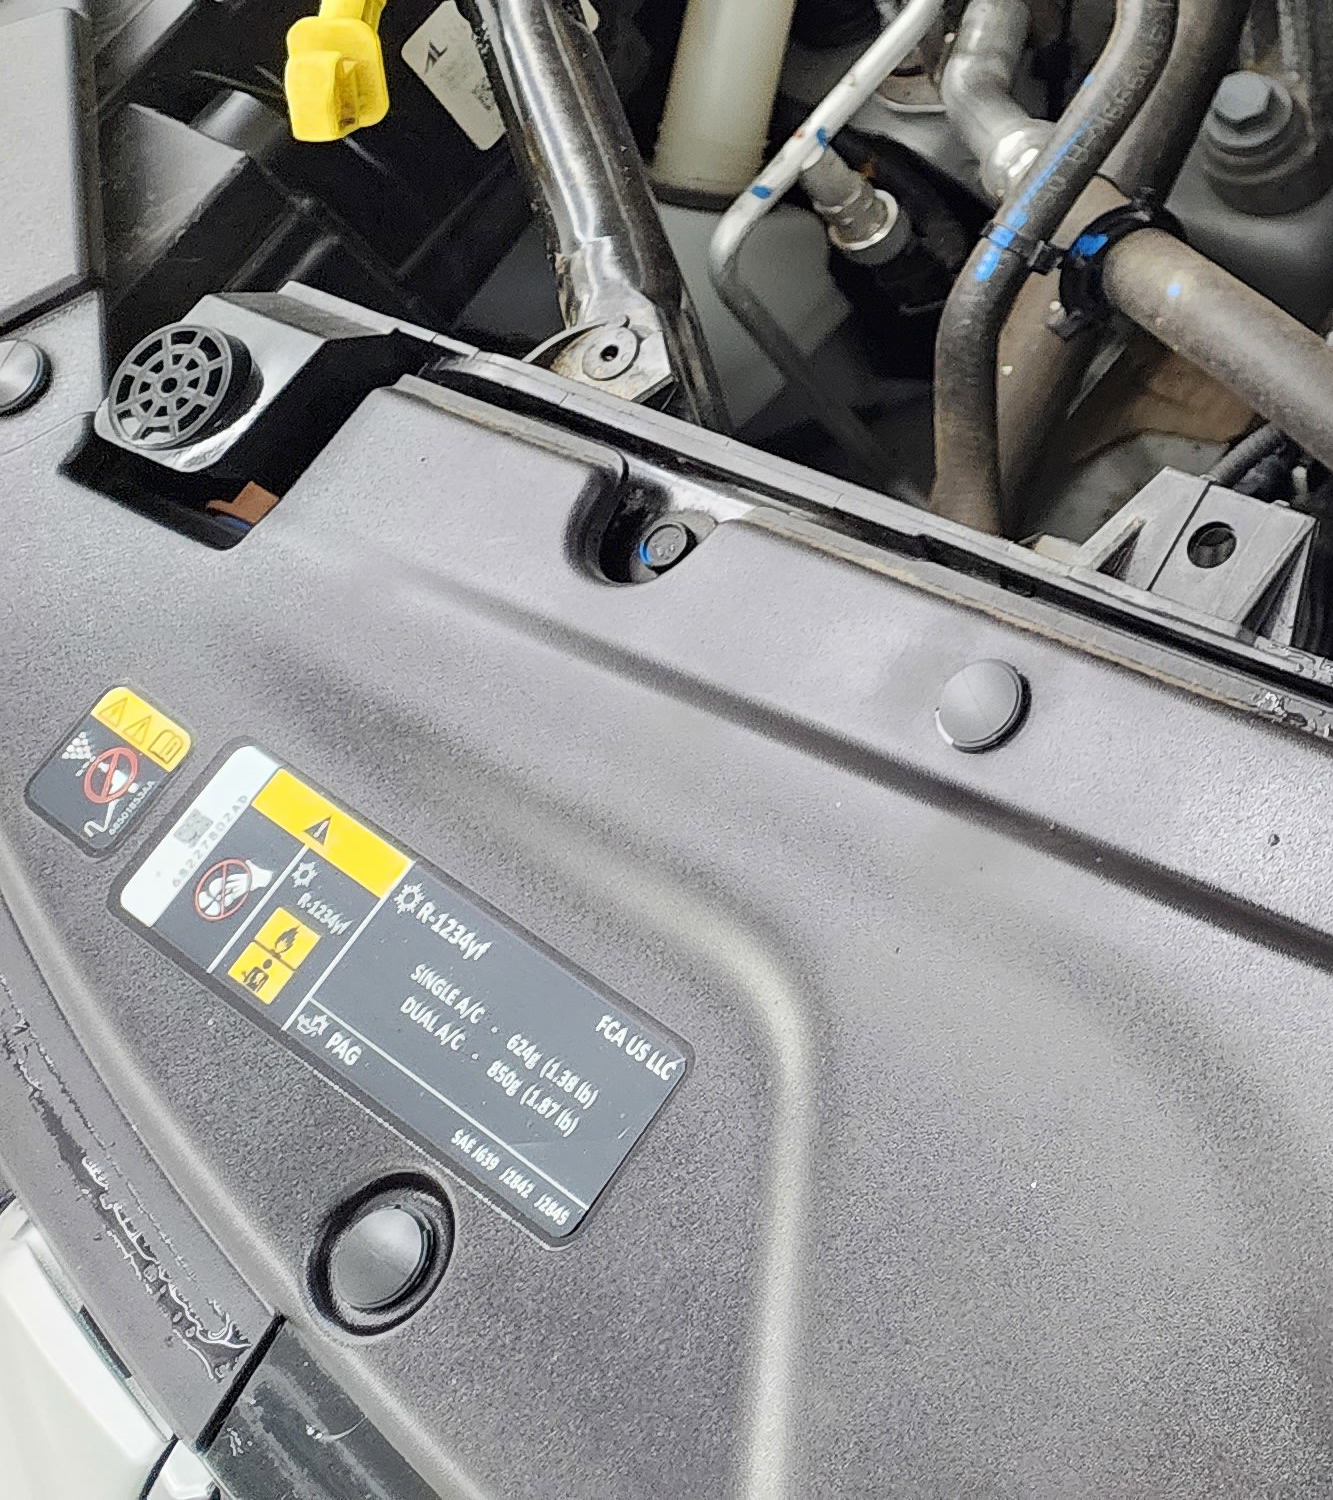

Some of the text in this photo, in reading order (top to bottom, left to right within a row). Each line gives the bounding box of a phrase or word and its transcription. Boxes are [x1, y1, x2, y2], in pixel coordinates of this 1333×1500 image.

[297, 891, 353, 937] R-1234yf
[416, 901, 492, 961] R-1234yf
[324, 1031, 362, 1066] PAG
[400, 995, 580, 1138] DUAL A/C 850g (1.87 lb)
[410, 963, 600, 1110] SINGLE A/C 624g (1.38 lb)
[594, 1014, 677, 1081] FCA US LLC
[450, 1128, 571, 1226] SAE J639 J2842 J2845
